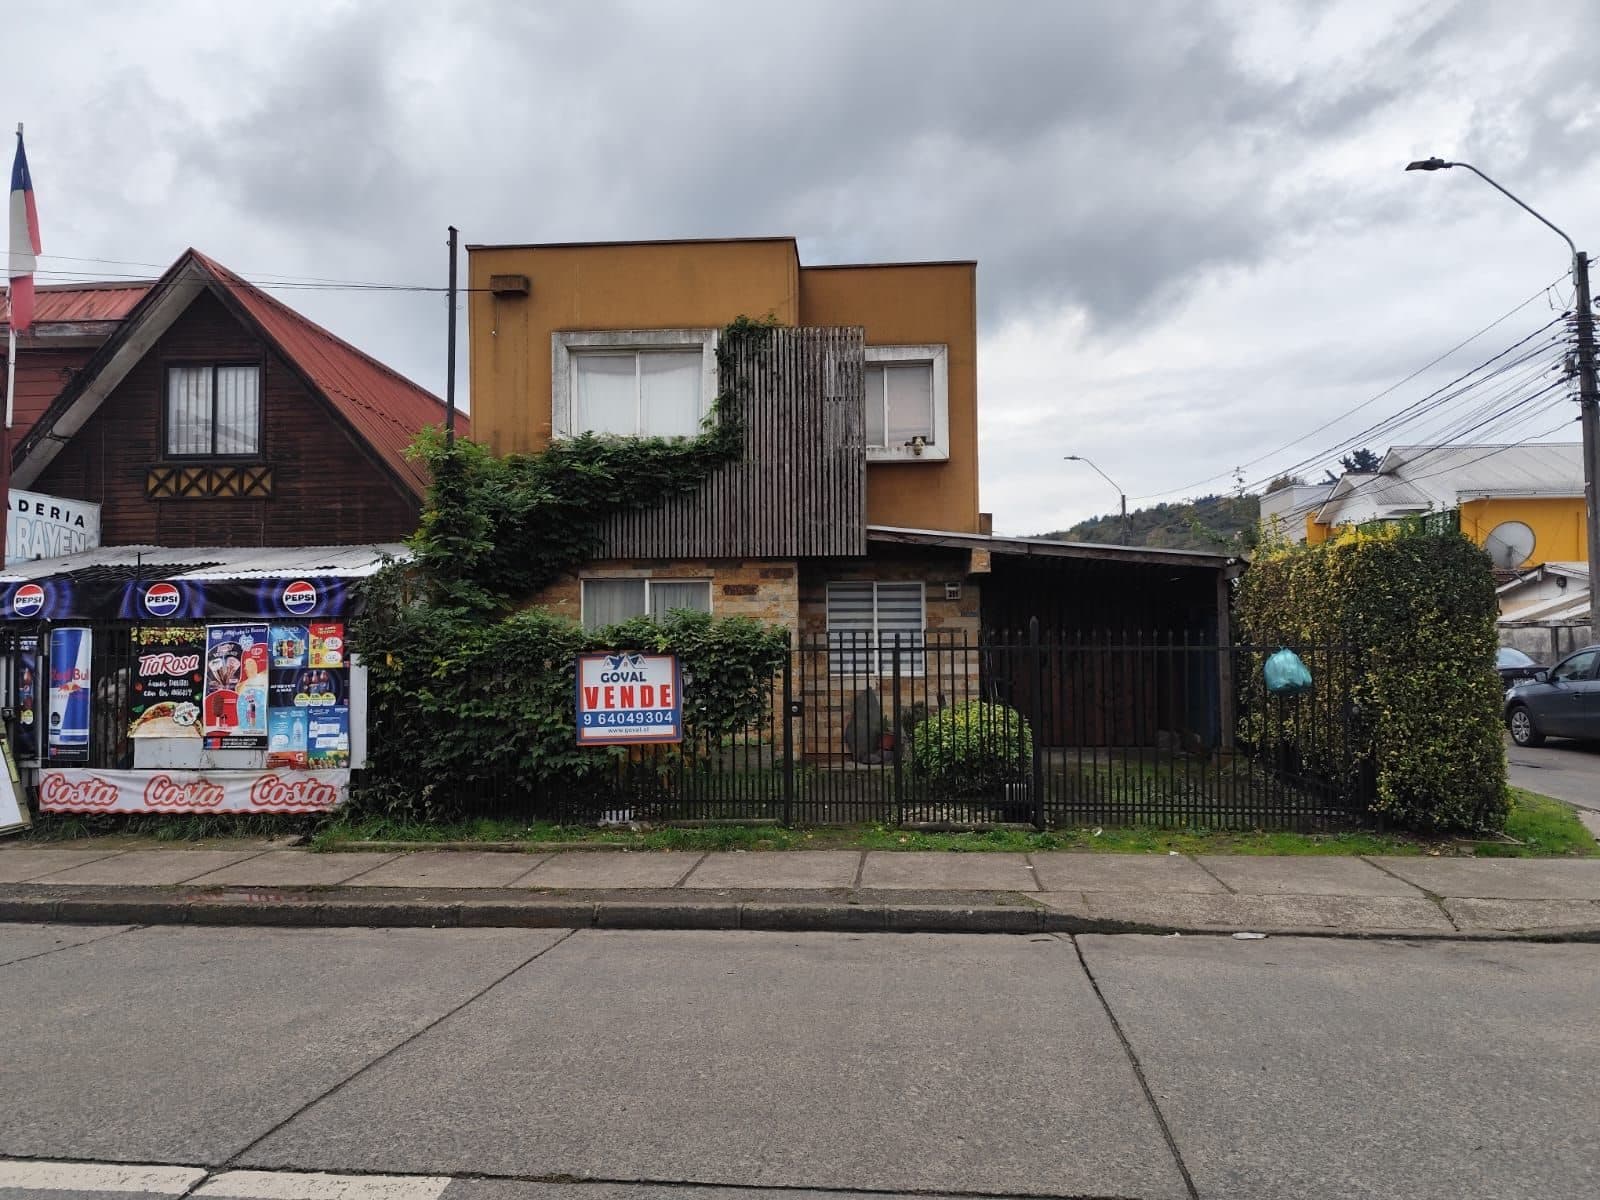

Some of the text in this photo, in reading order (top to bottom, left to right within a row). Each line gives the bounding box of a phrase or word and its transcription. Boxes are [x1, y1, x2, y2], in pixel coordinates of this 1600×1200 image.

[16, 516, 86, 559] RAYEN
[16, 596, 42, 604] PEPSI
[147, 595, 178, 604] PEPSI
[285, 594, 314, 602] PEPSI
[600, 671, 647, 683] GOVAL
[584, 684, 672, 709] VENDE
[583, 711, 673, 725] 9 64049304
[41, 773, 337, 807] Costa Costa Costa
